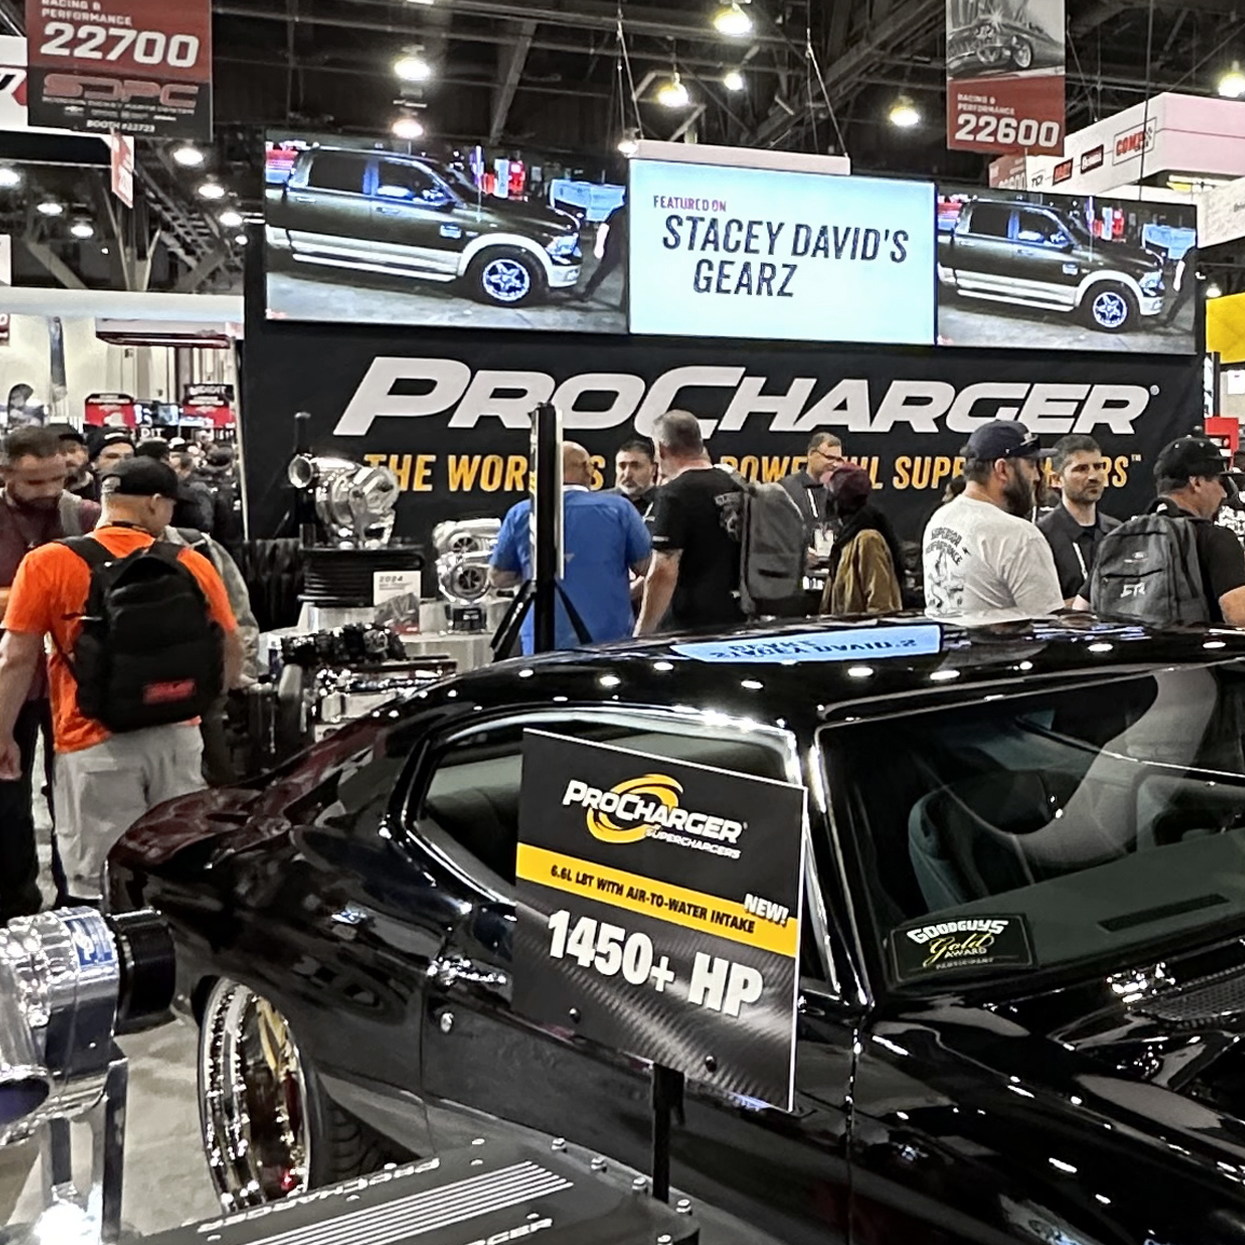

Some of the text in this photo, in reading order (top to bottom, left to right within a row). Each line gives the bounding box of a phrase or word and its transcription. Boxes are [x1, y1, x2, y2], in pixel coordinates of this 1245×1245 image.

[42, 0, 88, 9] RACING
[42, 9, 132, 26] PERFORMANCE
[40, 22, 199, 68] 22700
[86, 119, 120, 130] BOOTH
[955, 114, 1060, 148] 22600
[653, 195, 727, 212] FEATURED ON
[662, 214, 909, 263] STACEY DAVID'S
[693, 258, 798, 297] GEARZ
[333, 356, 1149, 438] PROCHARGER
[364, 454, 437, 491] THE
[563, 780, 744, 844] PROCHARGER
[644, 826, 742, 860] SUPERCHARGERS
[551, 864, 573, 881] 6.6L
[596, 876, 625, 895] WITH
[626, 885, 708, 921] AIR-TO-WATER
[711, 910, 755, 934] INTAKE
[743, 893, 789, 927] NEW!
[906, 919, 1009, 944] GOODGUYS
[548, 909, 763, 1017] 1450+ HP
[922, 932, 995, 968] Gold
[944, 947, 987, 959] AWARD
